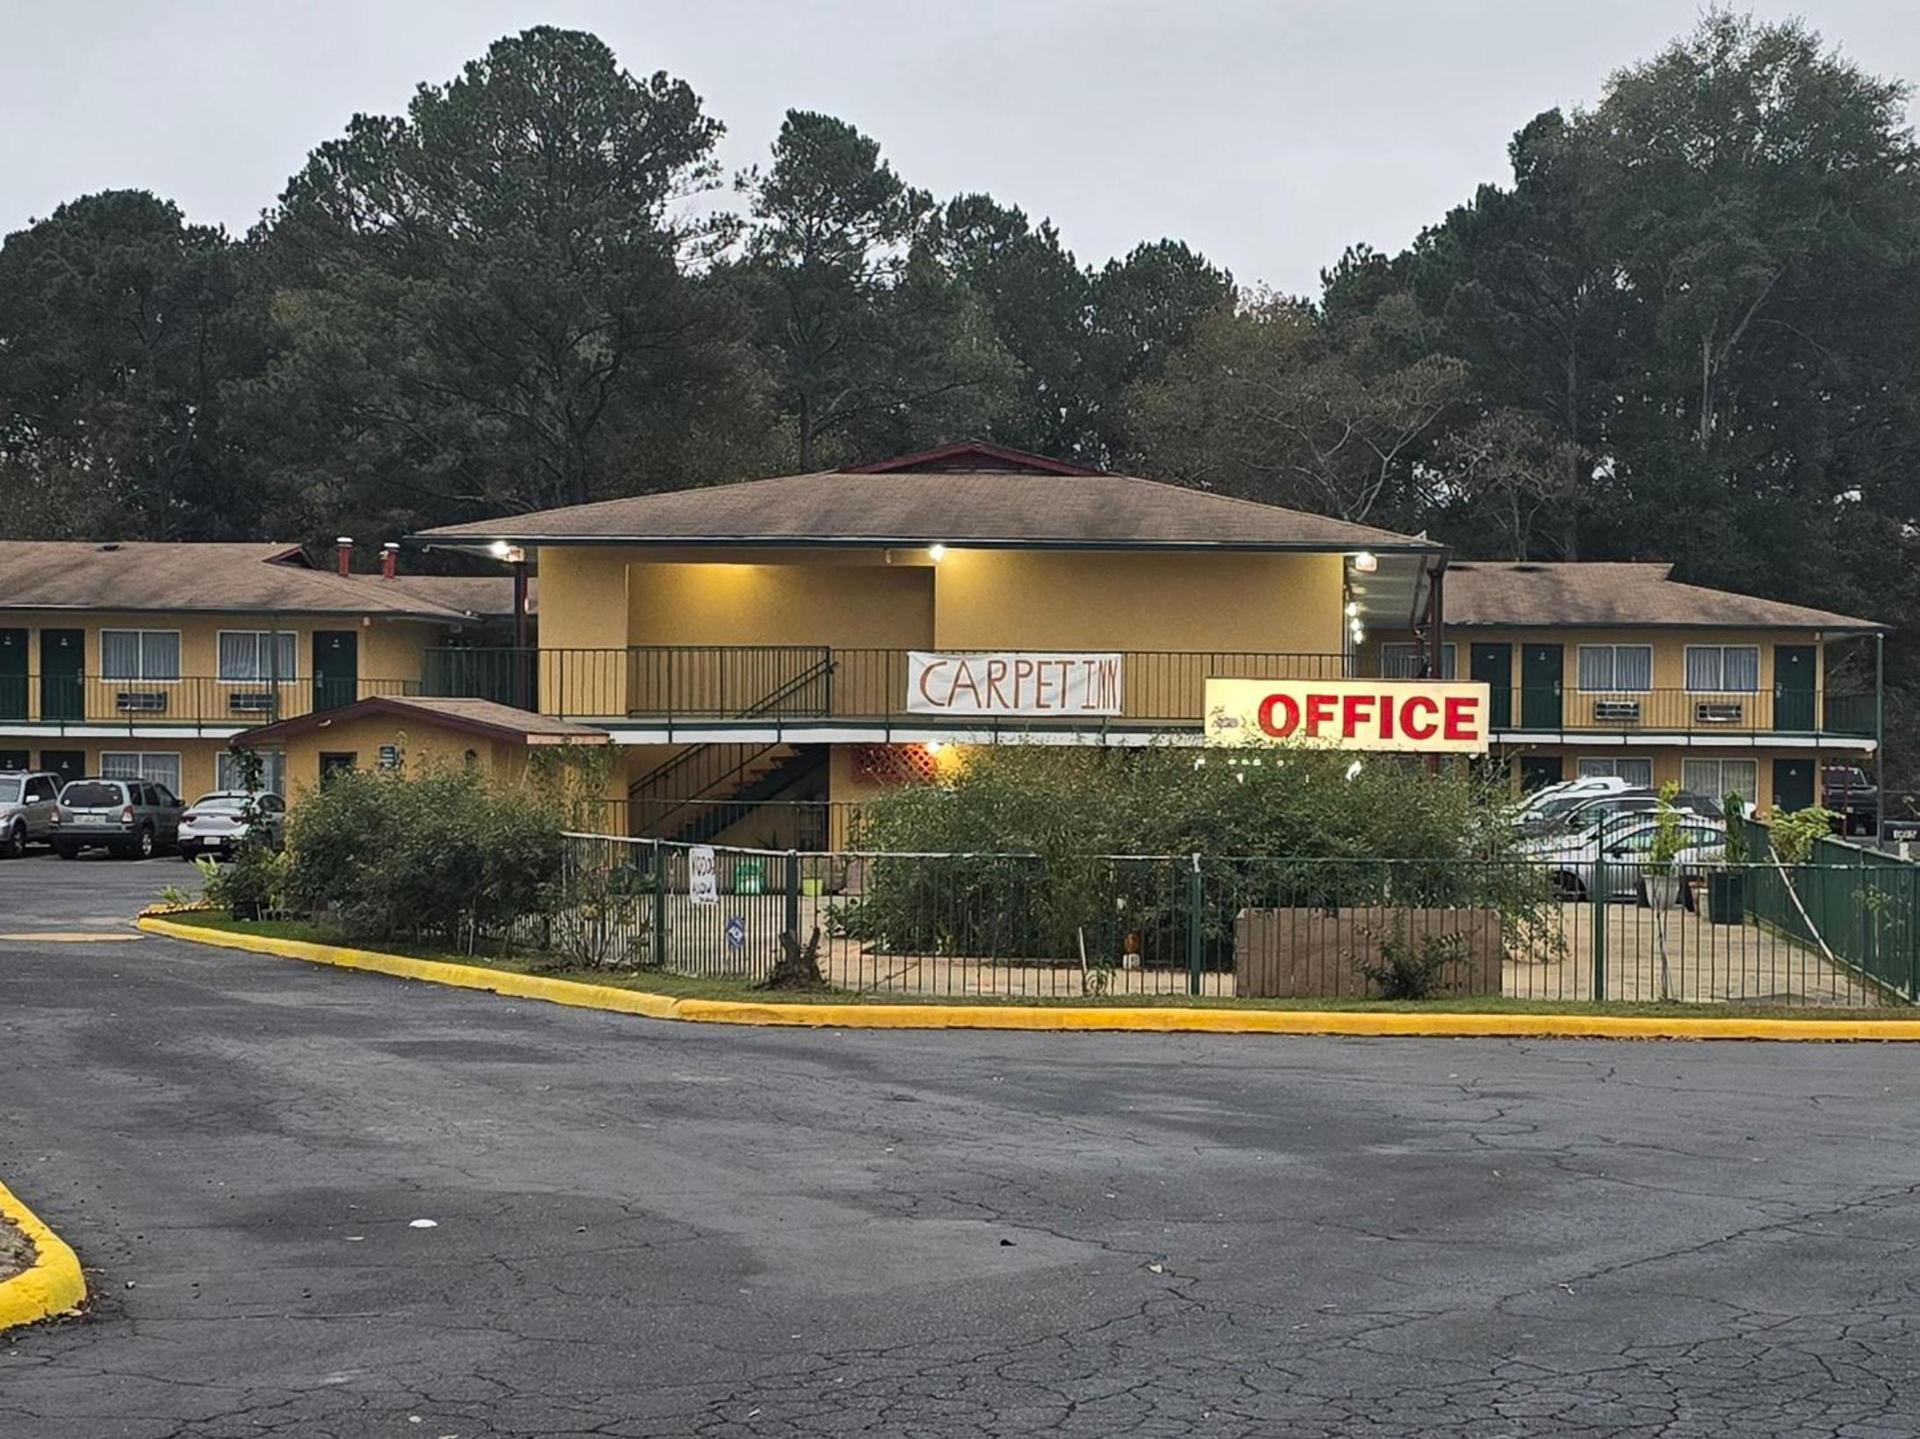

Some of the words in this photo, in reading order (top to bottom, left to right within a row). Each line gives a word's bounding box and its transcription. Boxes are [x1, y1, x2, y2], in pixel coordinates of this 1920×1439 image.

[919, 659, 1075, 709] CARPET
[1081, 659, 1118, 709] INN
[1257, 693, 1479, 741] OFFICE
